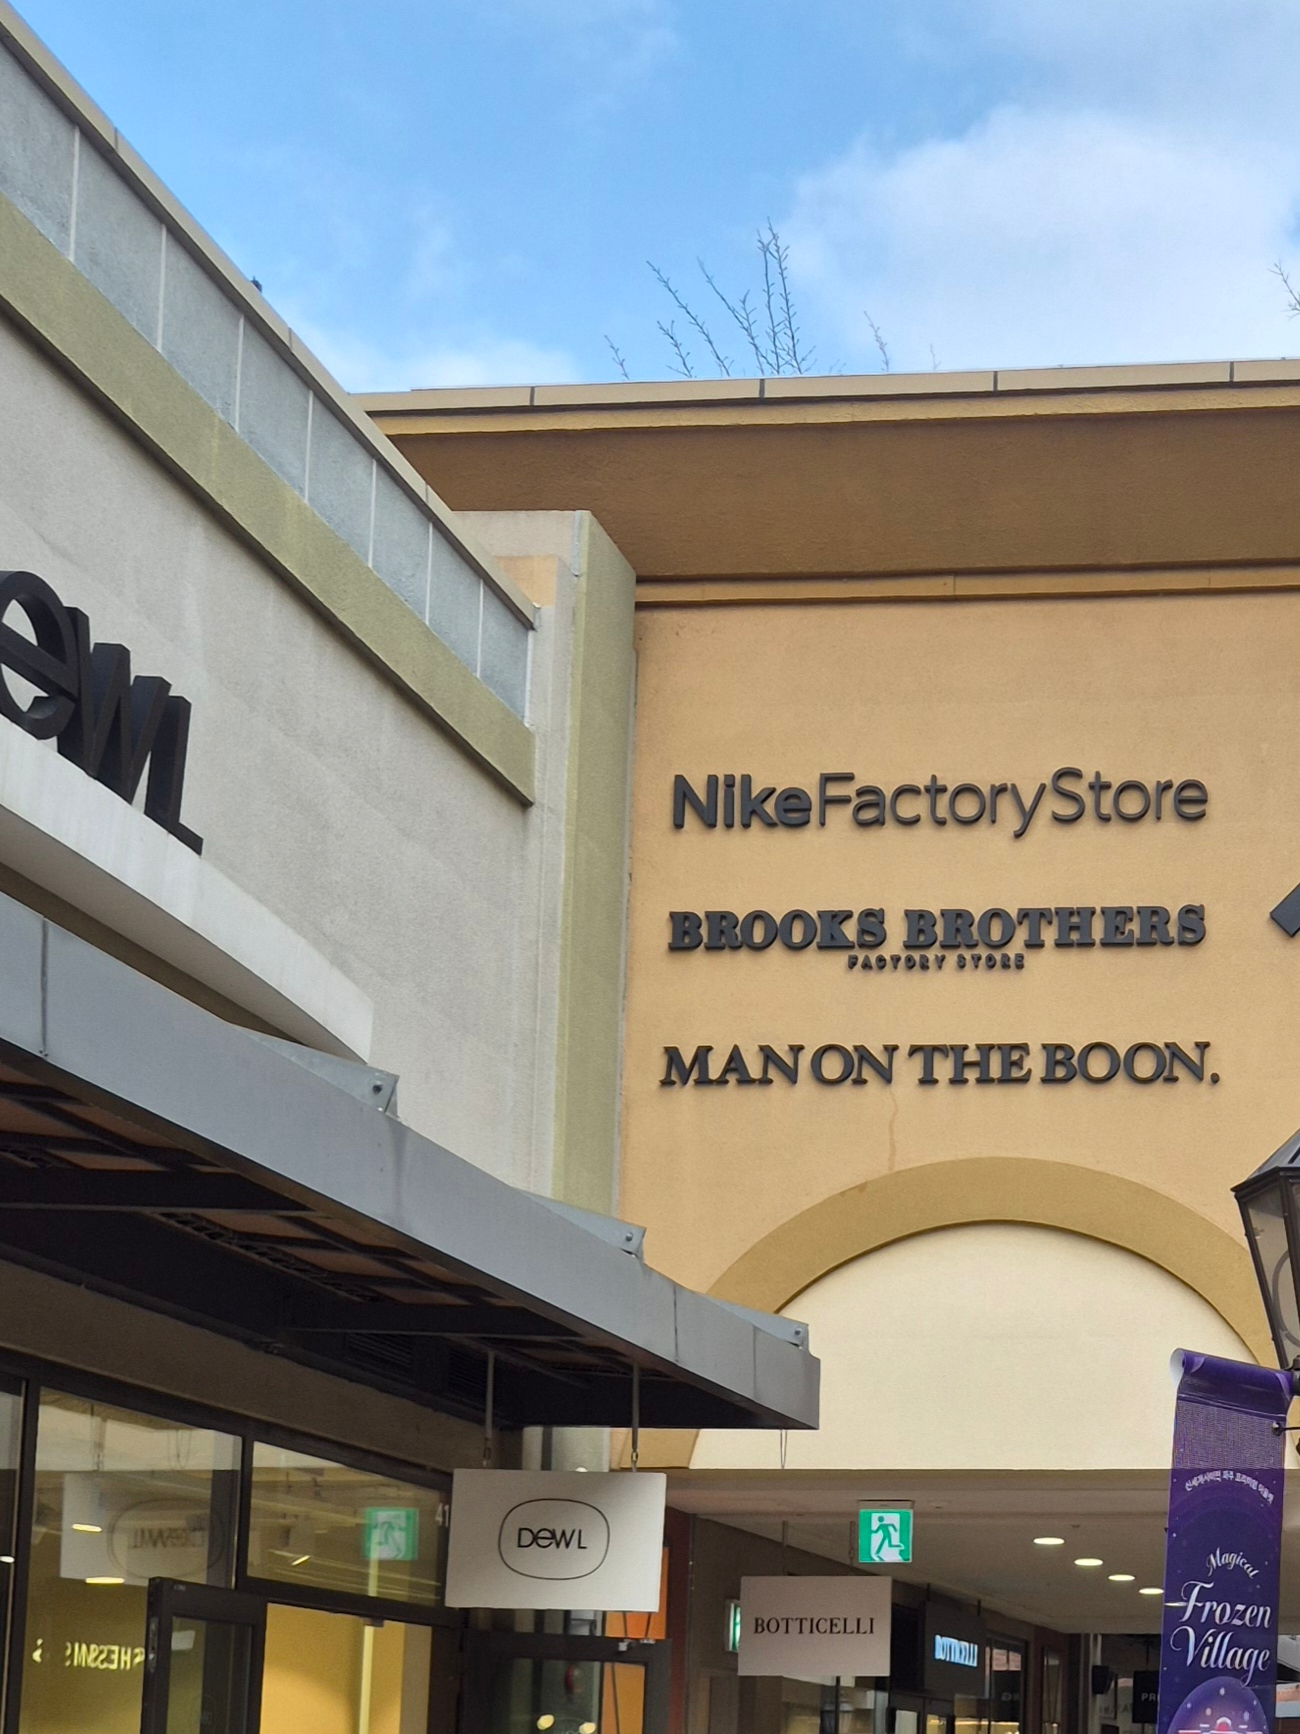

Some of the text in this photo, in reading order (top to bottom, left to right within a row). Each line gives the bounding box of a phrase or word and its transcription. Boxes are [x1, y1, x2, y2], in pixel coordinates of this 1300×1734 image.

[667, 904, 1206, 952] BROOKS BROTHERS
[847, 953, 1025, 970] FACTORY STORE
[659, 1041, 1220, 1087] MAN ON THE BOON.
[1206, 1547, 1260, 1579] Magical
[754, 1617, 875, 1634] BOTTICELLI
[1181, 1581, 1271, 1628] Frozen
[1170, 1625, 1270, 1688] Village
